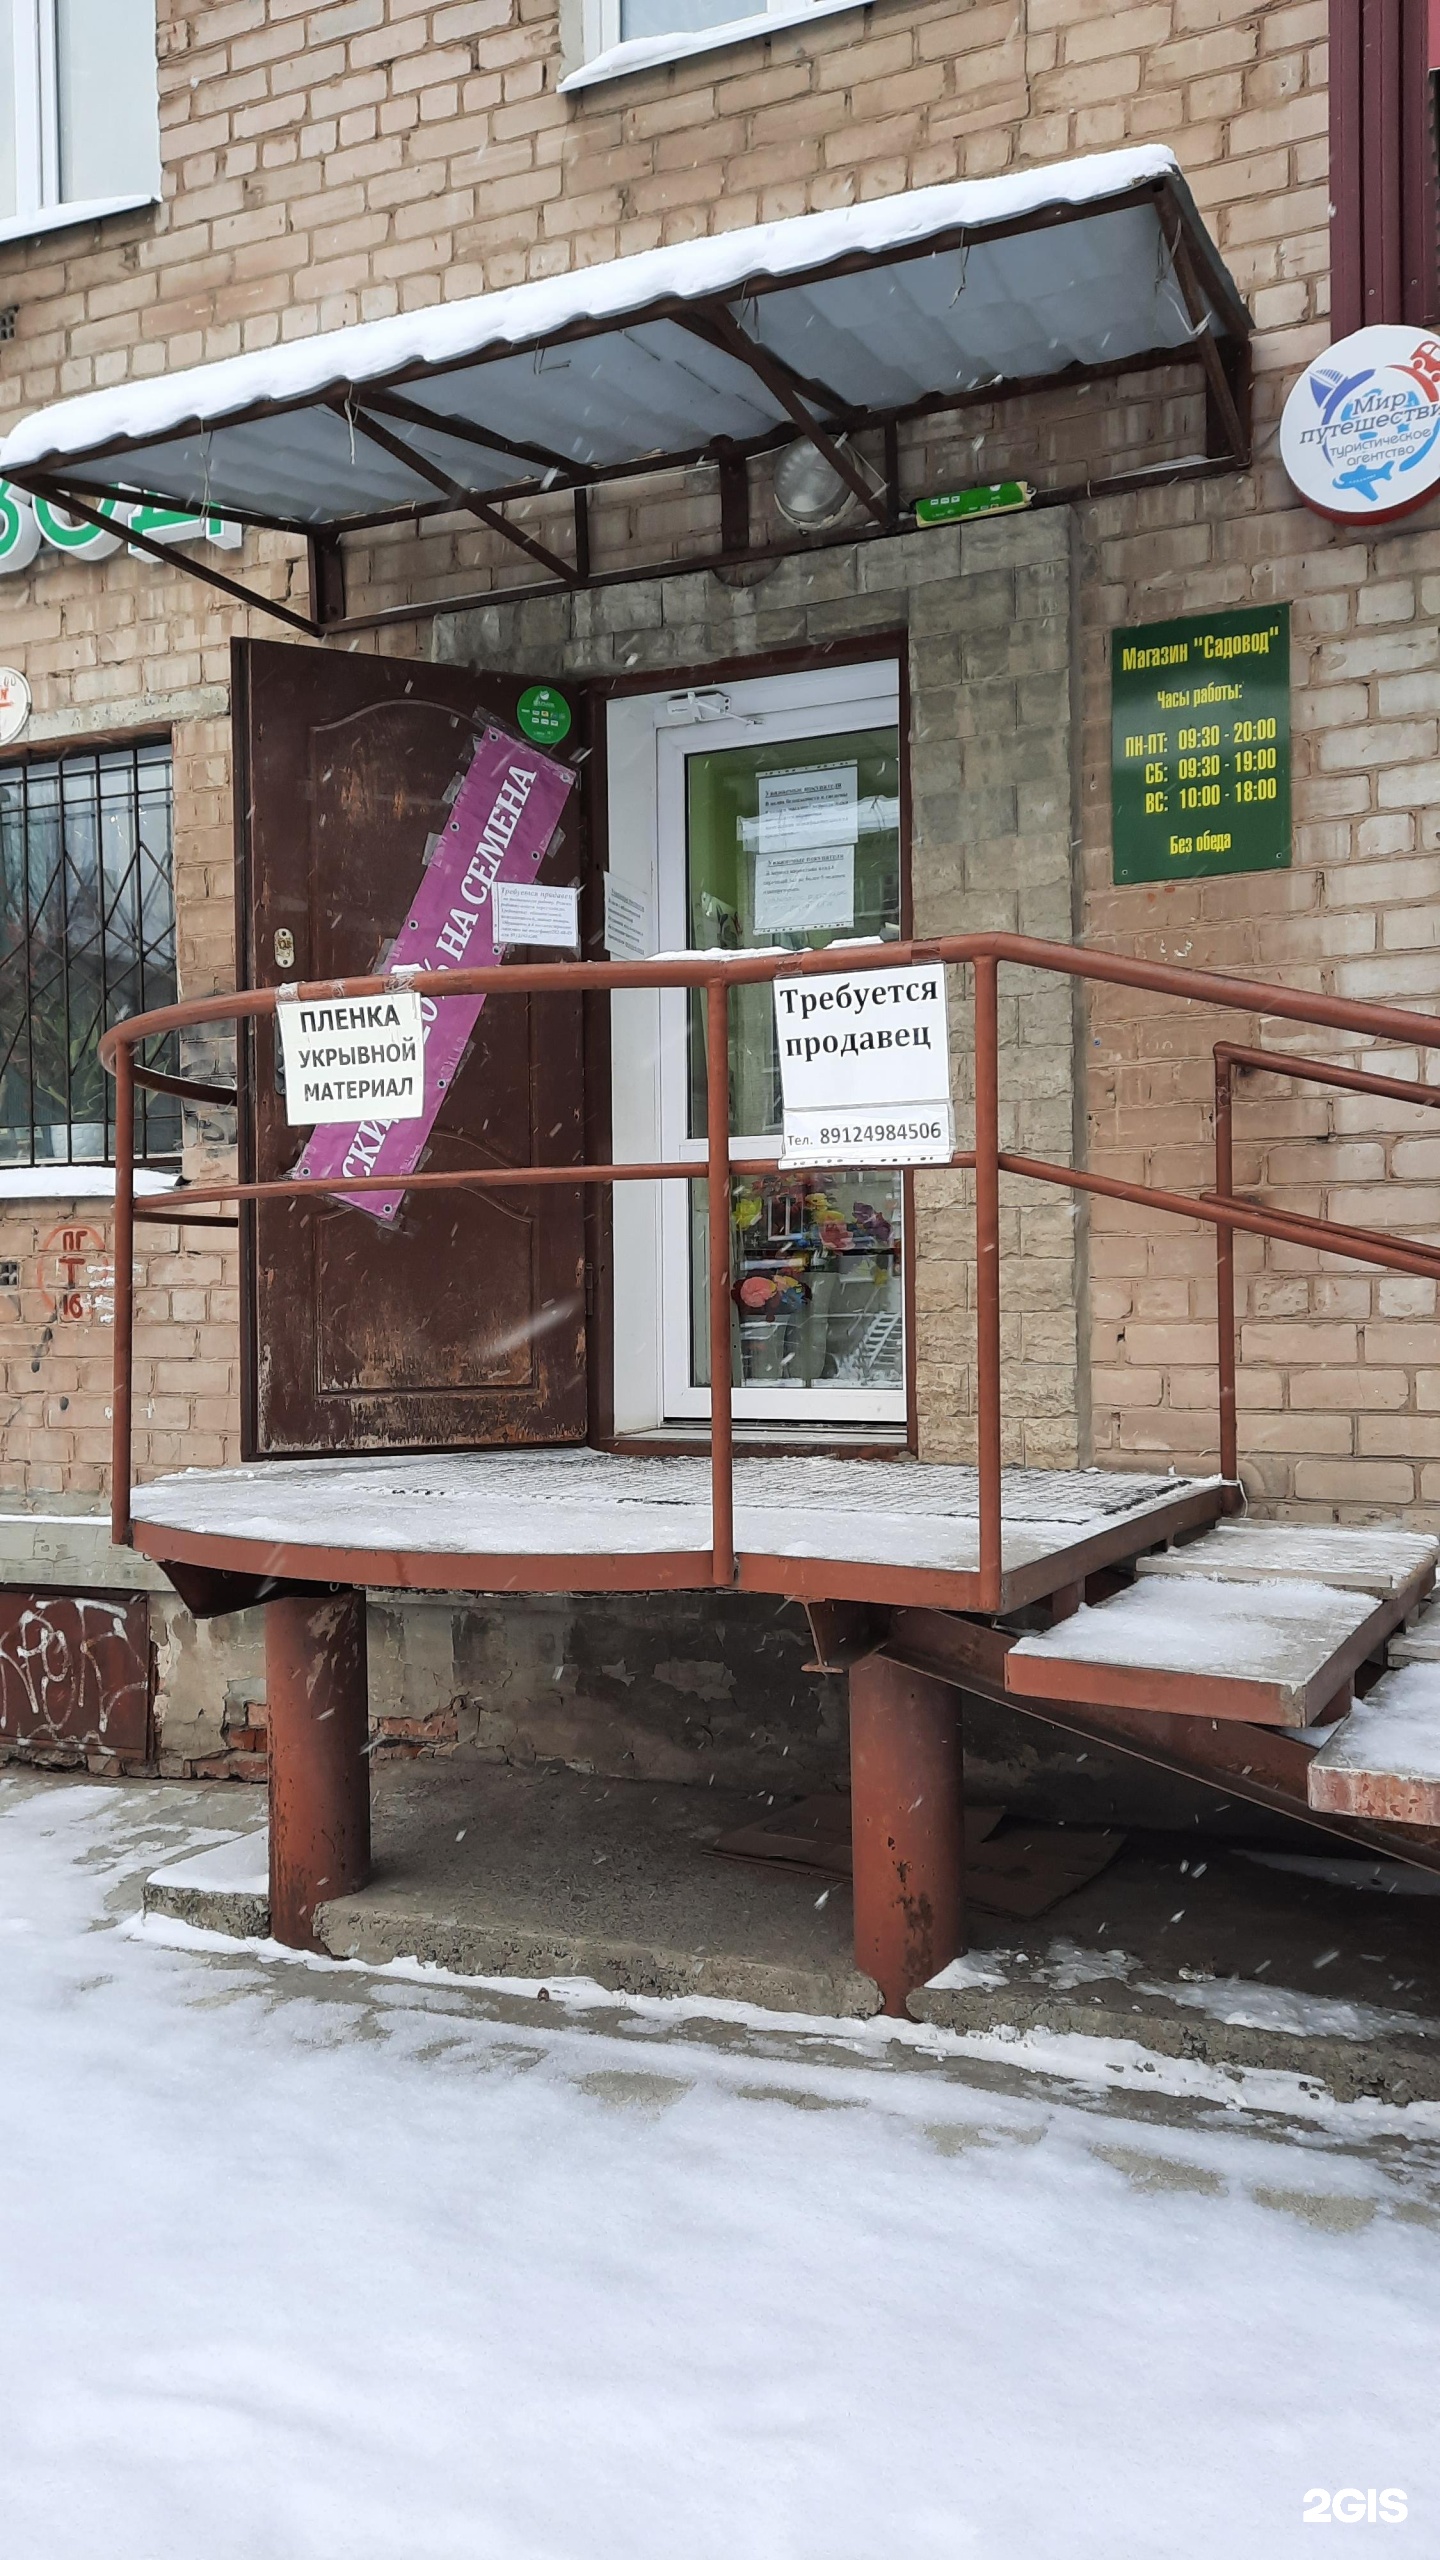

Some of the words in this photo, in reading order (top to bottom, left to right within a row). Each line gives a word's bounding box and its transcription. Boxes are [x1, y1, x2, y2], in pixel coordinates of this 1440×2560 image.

[1352, 392, 1406, 415] Мир
[1330, 428, 1431, 458] туристическое
[1347, 445, 1416, 467] агентство
[1122, 642, 1188, 671] Магазин
[1194, 626, 1279, 659] "Садовод"
[1157, 688, 1190, 709] Часы
[1193, 682, 1243, 708] работы:
[1125, 732, 1168, 757] ПН-ПТ:
[1178, 724, 1220, 750] 09:30
[1233, 717, 1277, 744] 20:00
[1145, 762, 1168, 785] СБ:
[1178, 754, 1220, 781] 09:30
[1235, 747, 1277, 774] 19:00
[1145, 791, 1168, 814] ВС:
[1179, 784, 1221, 810] 10:00
[1235, 777, 1277, 803] 18:00
[1169, 835, 1193, 855] Без
[1196, 829, 1232, 853] обеда
[435, 908, 479, 962] НА
[460, 765, 538, 905] СЕМЕНА
[779, 980, 938, 1020] Требуется
[300, 1004, 401, 1033] ПЛЕНКА
[298, 1036, 416, 1069] УКРЫВНОЙ
[785, 1025, 932, 1062] продавец
[304, 1077, 413, 1102] МАТЕРИАЛ
[787, 1135, 813, 1147] Тел.
[820, 1121, 942, 1145] 89124984506
